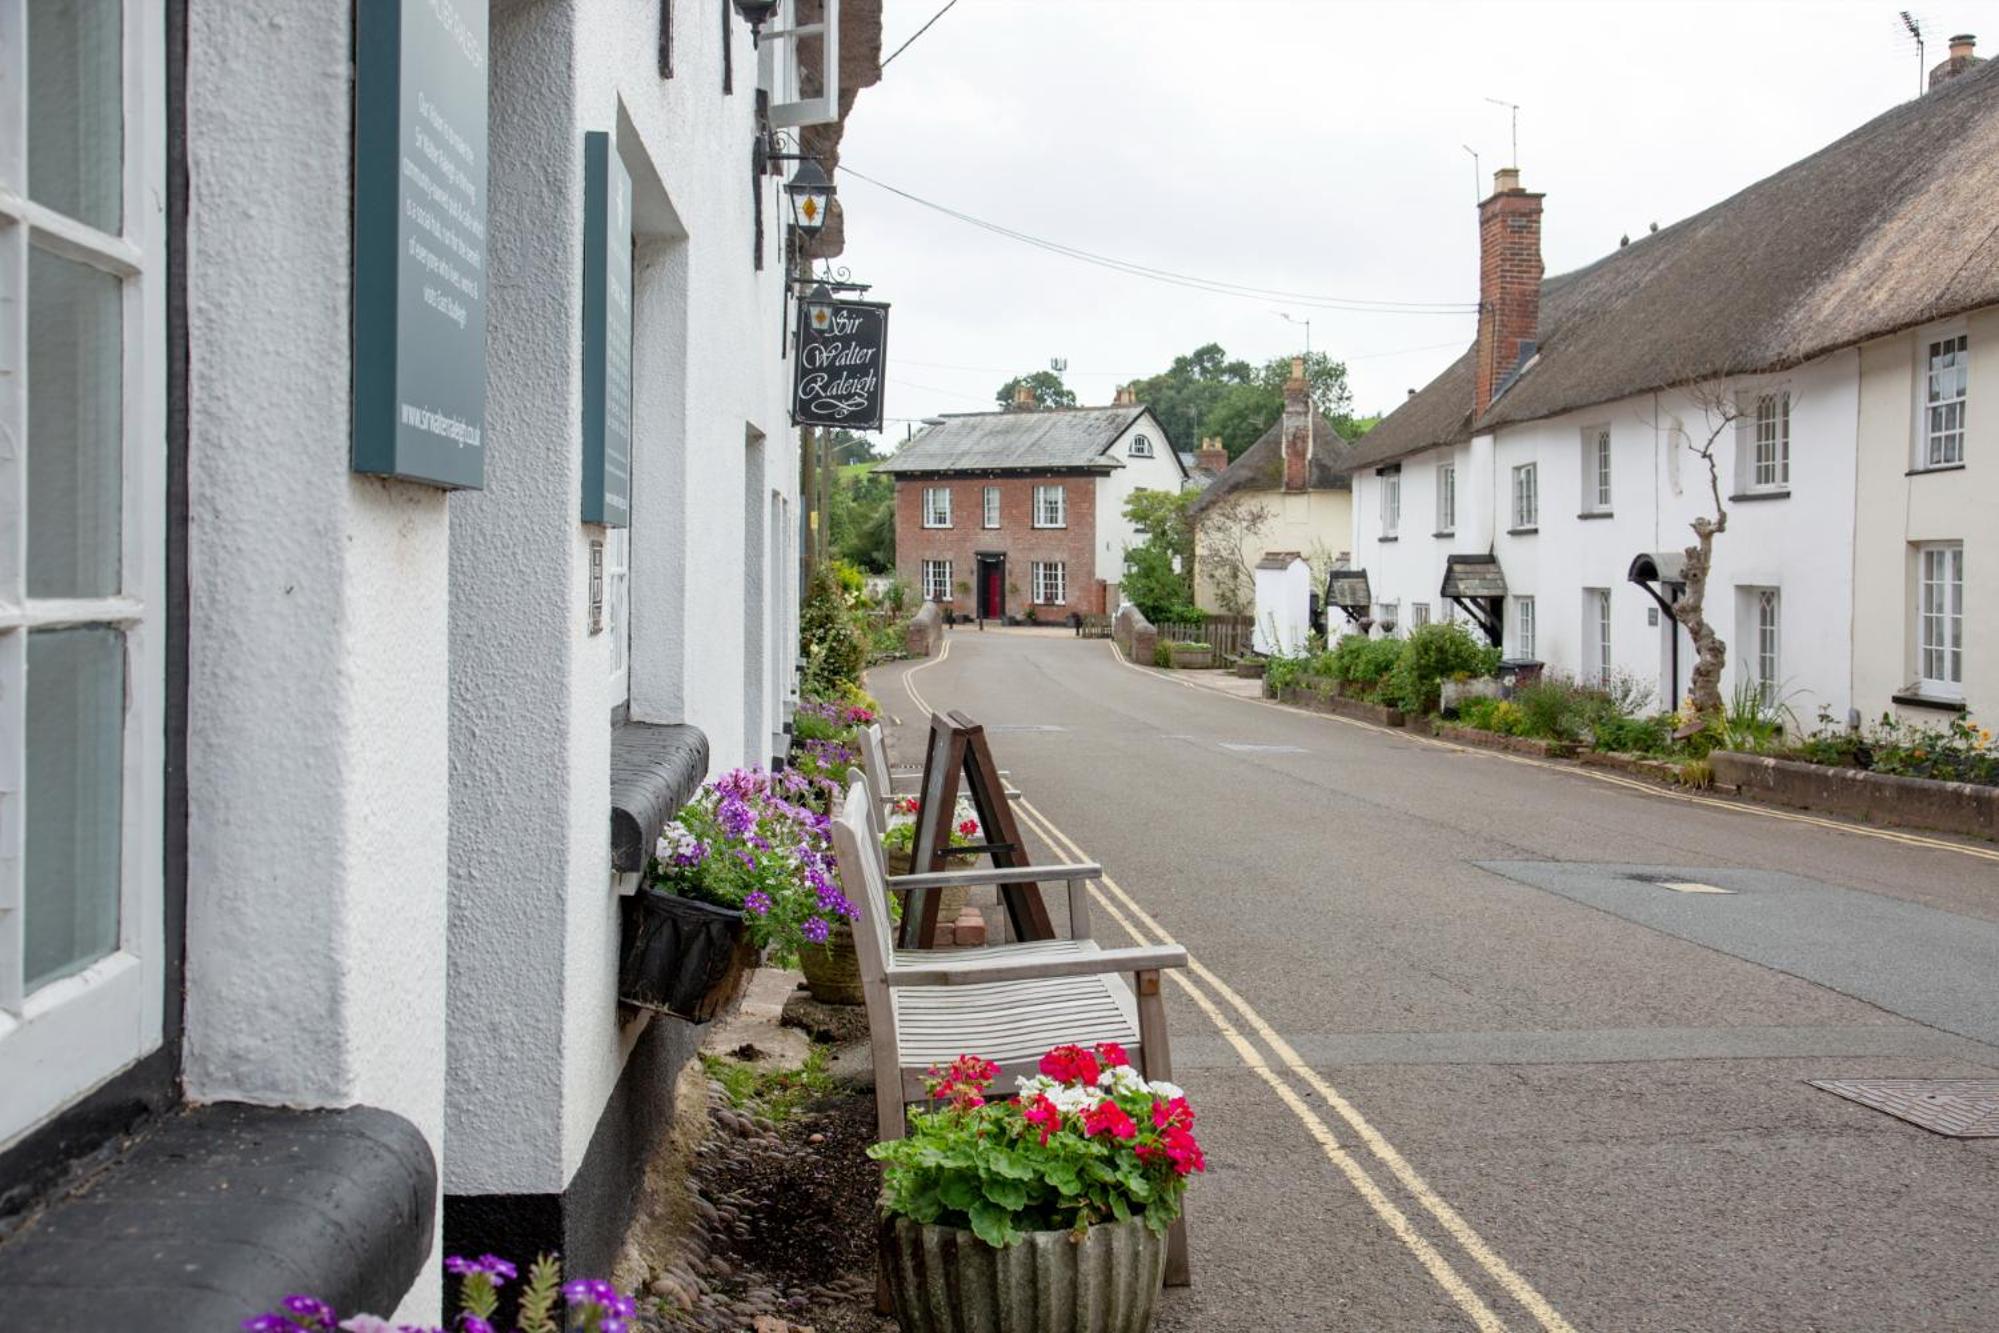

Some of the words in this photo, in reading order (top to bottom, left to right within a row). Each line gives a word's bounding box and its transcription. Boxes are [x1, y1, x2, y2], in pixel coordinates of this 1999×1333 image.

[825, 310, 863, 337] Sir
[802, 341, 877, 369] Walter
[799, 368, 877, 399] Raleigh
